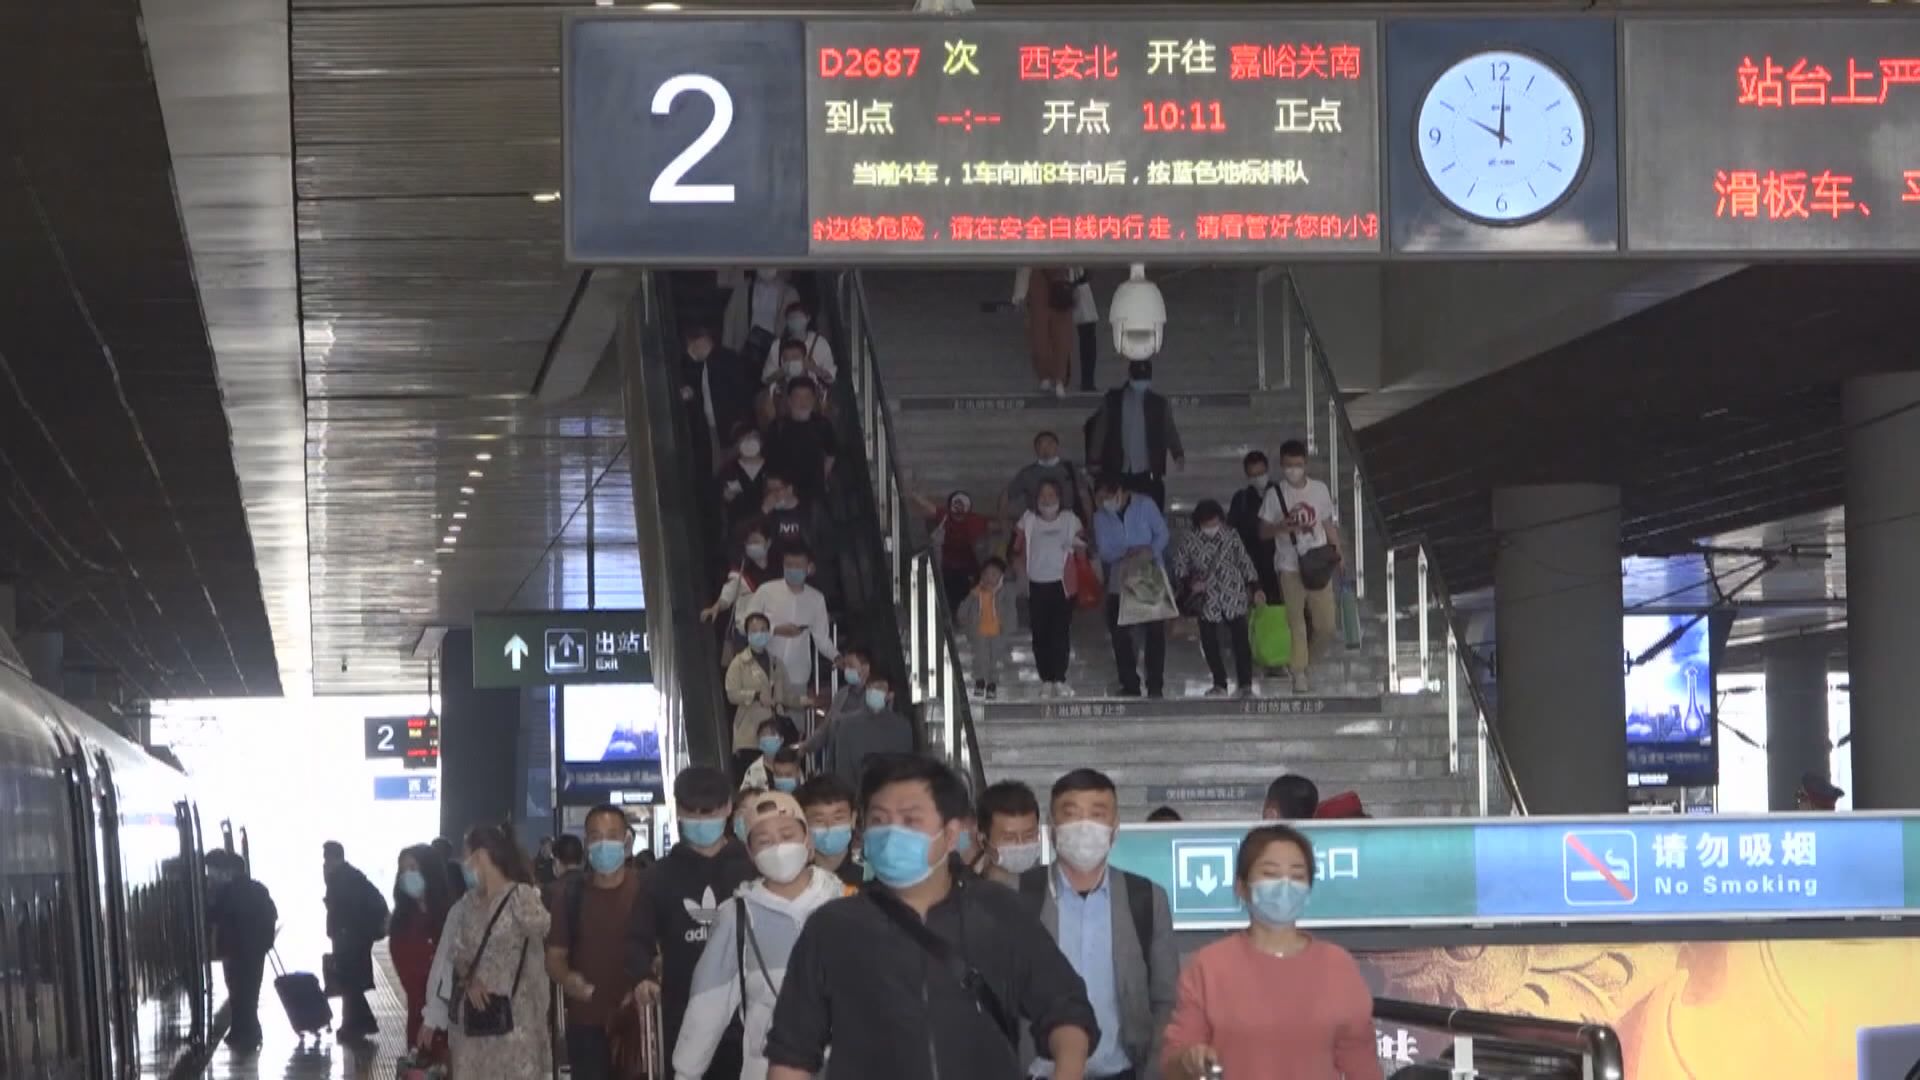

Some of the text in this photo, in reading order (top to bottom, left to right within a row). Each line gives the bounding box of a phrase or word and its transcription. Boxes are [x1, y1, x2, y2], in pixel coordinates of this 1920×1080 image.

[819, 38, 1362, 80] D2687 次 西安北 开往 嘉峪关南
[1491, 61, 1511, 81] 12
[825, 99, 895, 135] 到点
[1042, 98, 1111, 134] 开点
[1143, 100, 1227, 133] 10:11
[1274, 97, 1343, 134] 正点
[649, 73, 736, 203] 2
[1428, 127, 1442, 148] 9
[1560, 126, 1574, 147] 3
[1495, 192, 1508, 213] 6
[596, 658, 618, 671] Exit
[377, 725, 395, 751] 2
[1652, 831, 1817, 868] 请勿吸烟
[1655, 874, 1817, 896] No Smoking
[685, 926, 708, 942] adi
